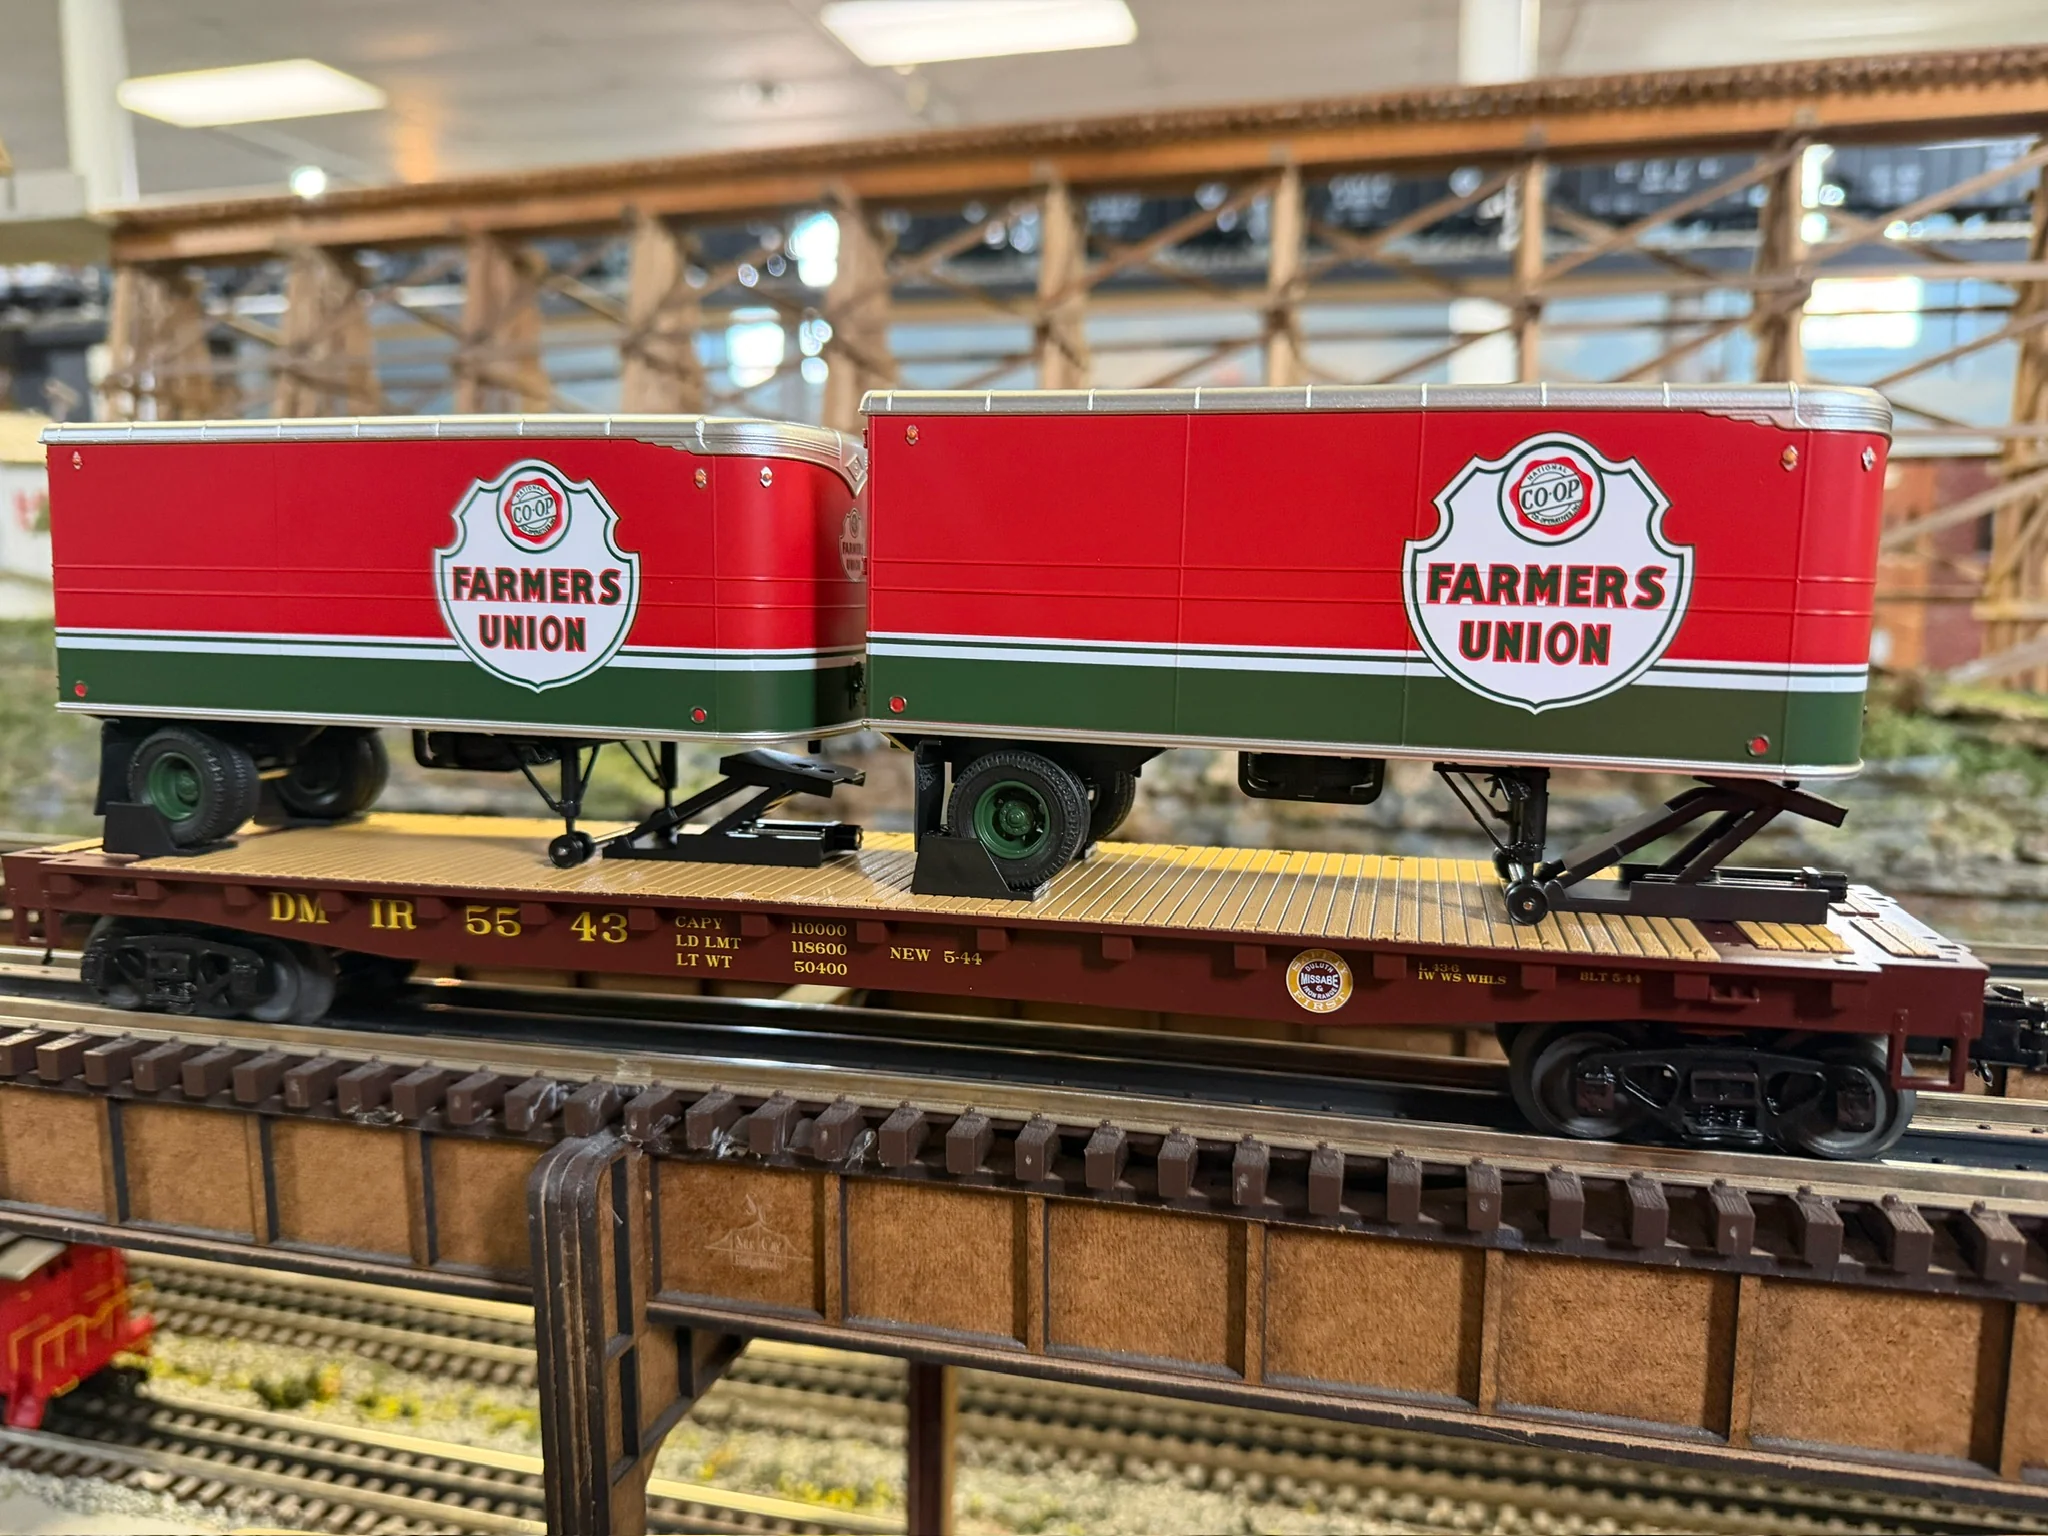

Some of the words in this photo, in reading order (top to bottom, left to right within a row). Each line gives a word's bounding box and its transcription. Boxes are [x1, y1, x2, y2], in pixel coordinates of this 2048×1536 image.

[1527, 464, 1567, 481] NATIONAL
[452, 566, 622, 606] FARMERS
[1426, 562, 1668, 610] FARMERS
[479, 614, 586, 653] UNION
[1458, 620, 1611, 666] UNION
[269, 892, 330, 924] DM
[369, 898, 416, 931] IR
[465, 905, 522, 937] 55
[569, 911, 628, 943] 43
[675, 916, 722, 931] CAPY
[791, 922, 847, 937] 110000
[675, 934, 699, 948] LD
[704, 936, 742, 950] LMT
[791, 940, 847, 956] 118600
[676, 953, 700, 967] LT
[706, 954, 733, 969] WT
[794, 960, 848, 976] 50400
[890, 947, 931, 962] NEW
[943, 950, 983, 965] 5-44
[1305, 962, 1334, 973] DULUTH
[1580, 971, 1608, 982] BLT
[1300, 972, 1339, 988] MISSABE
[1440, 972, 1462, 982] WS
[1466, 973, 1507, 985] WHLS
[1293, 990, 1345, 1010] FIRST
[1302, 986, 1317, 999] IRON
[1317, 987, 1338, 999] RANGE
